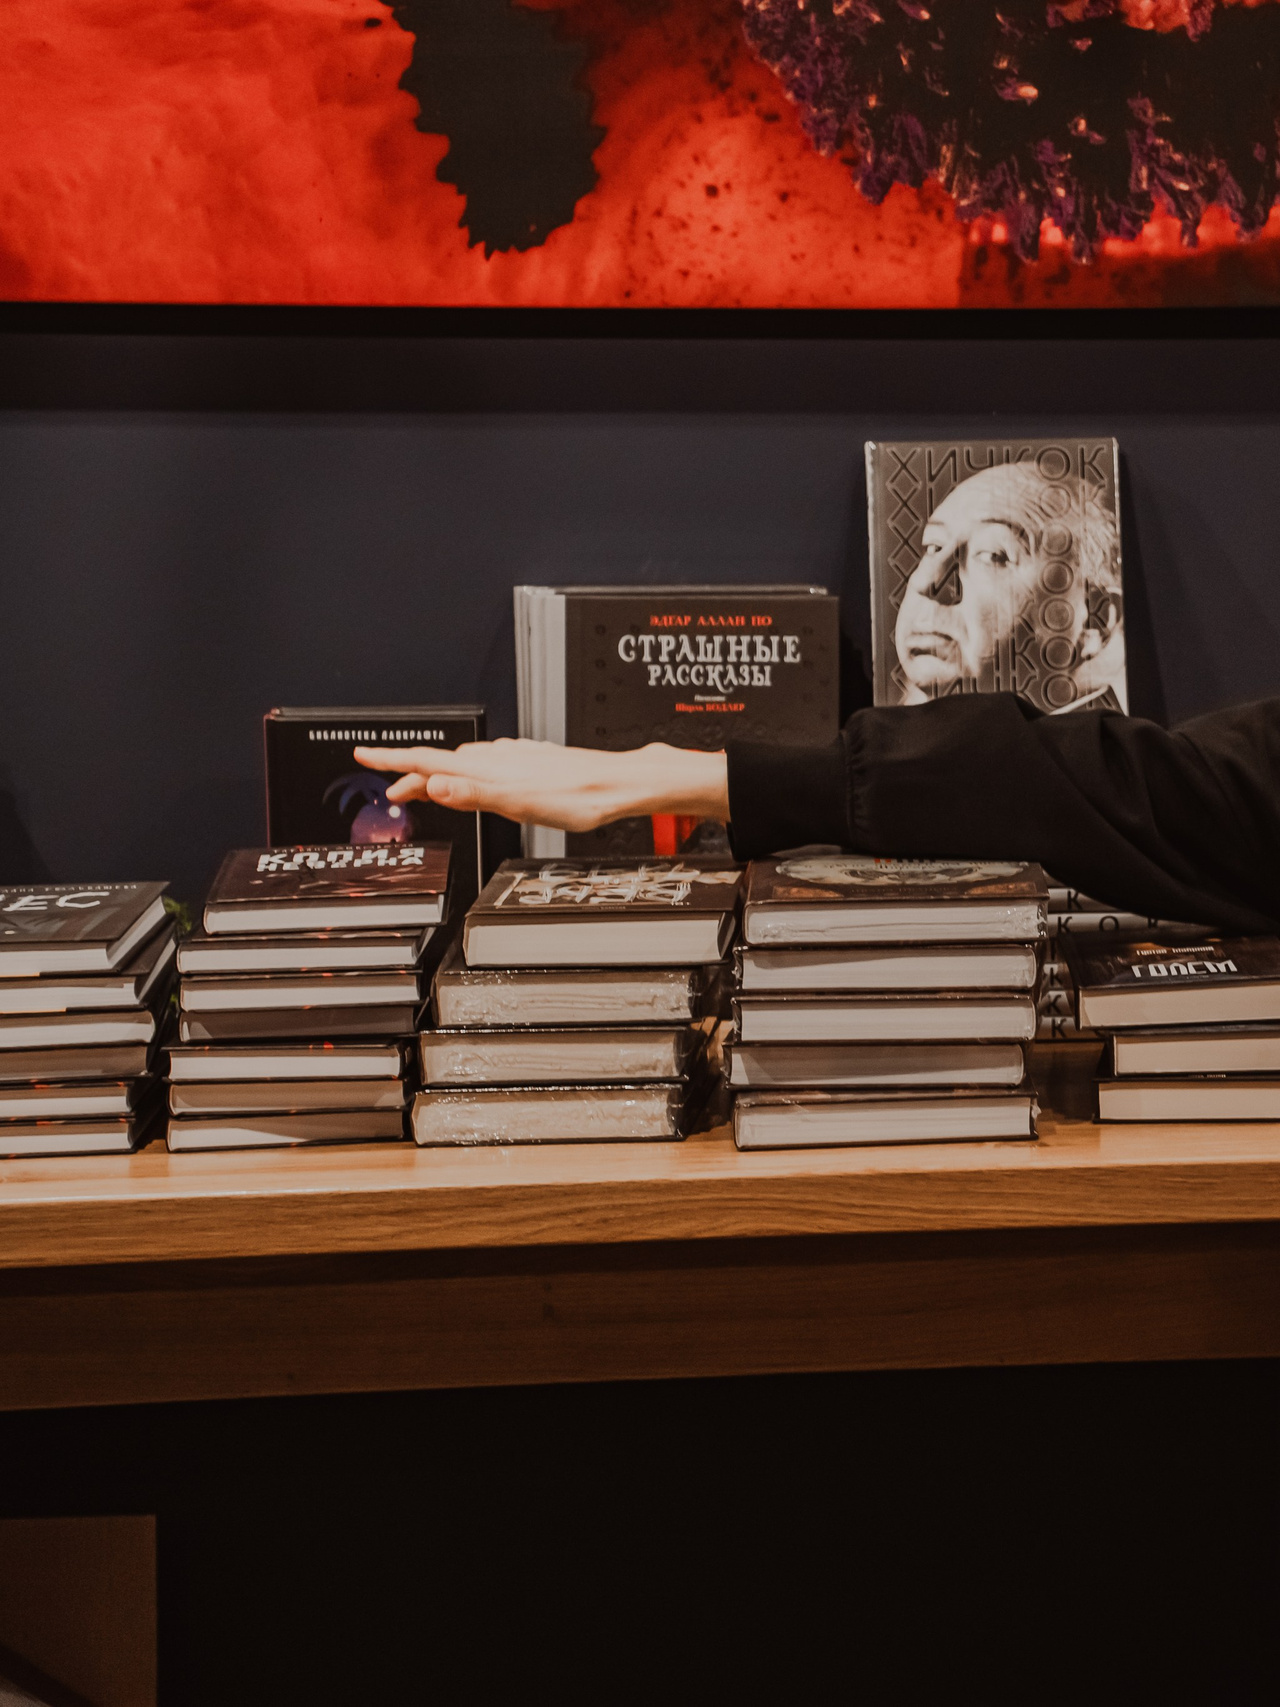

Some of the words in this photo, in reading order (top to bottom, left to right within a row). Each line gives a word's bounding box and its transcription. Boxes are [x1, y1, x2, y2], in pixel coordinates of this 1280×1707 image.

[649, 615, 692, 627] ЭДГАР
[697, 615, 746, 627] АЛЛАН
[751, 615, 773, 627] ПО
[617, 633, 801, 663] СТРАШНЫЕ
[647, 664, 772, 694] РАССКАЗЫ
[0, 891, 110, 912] ЕС
